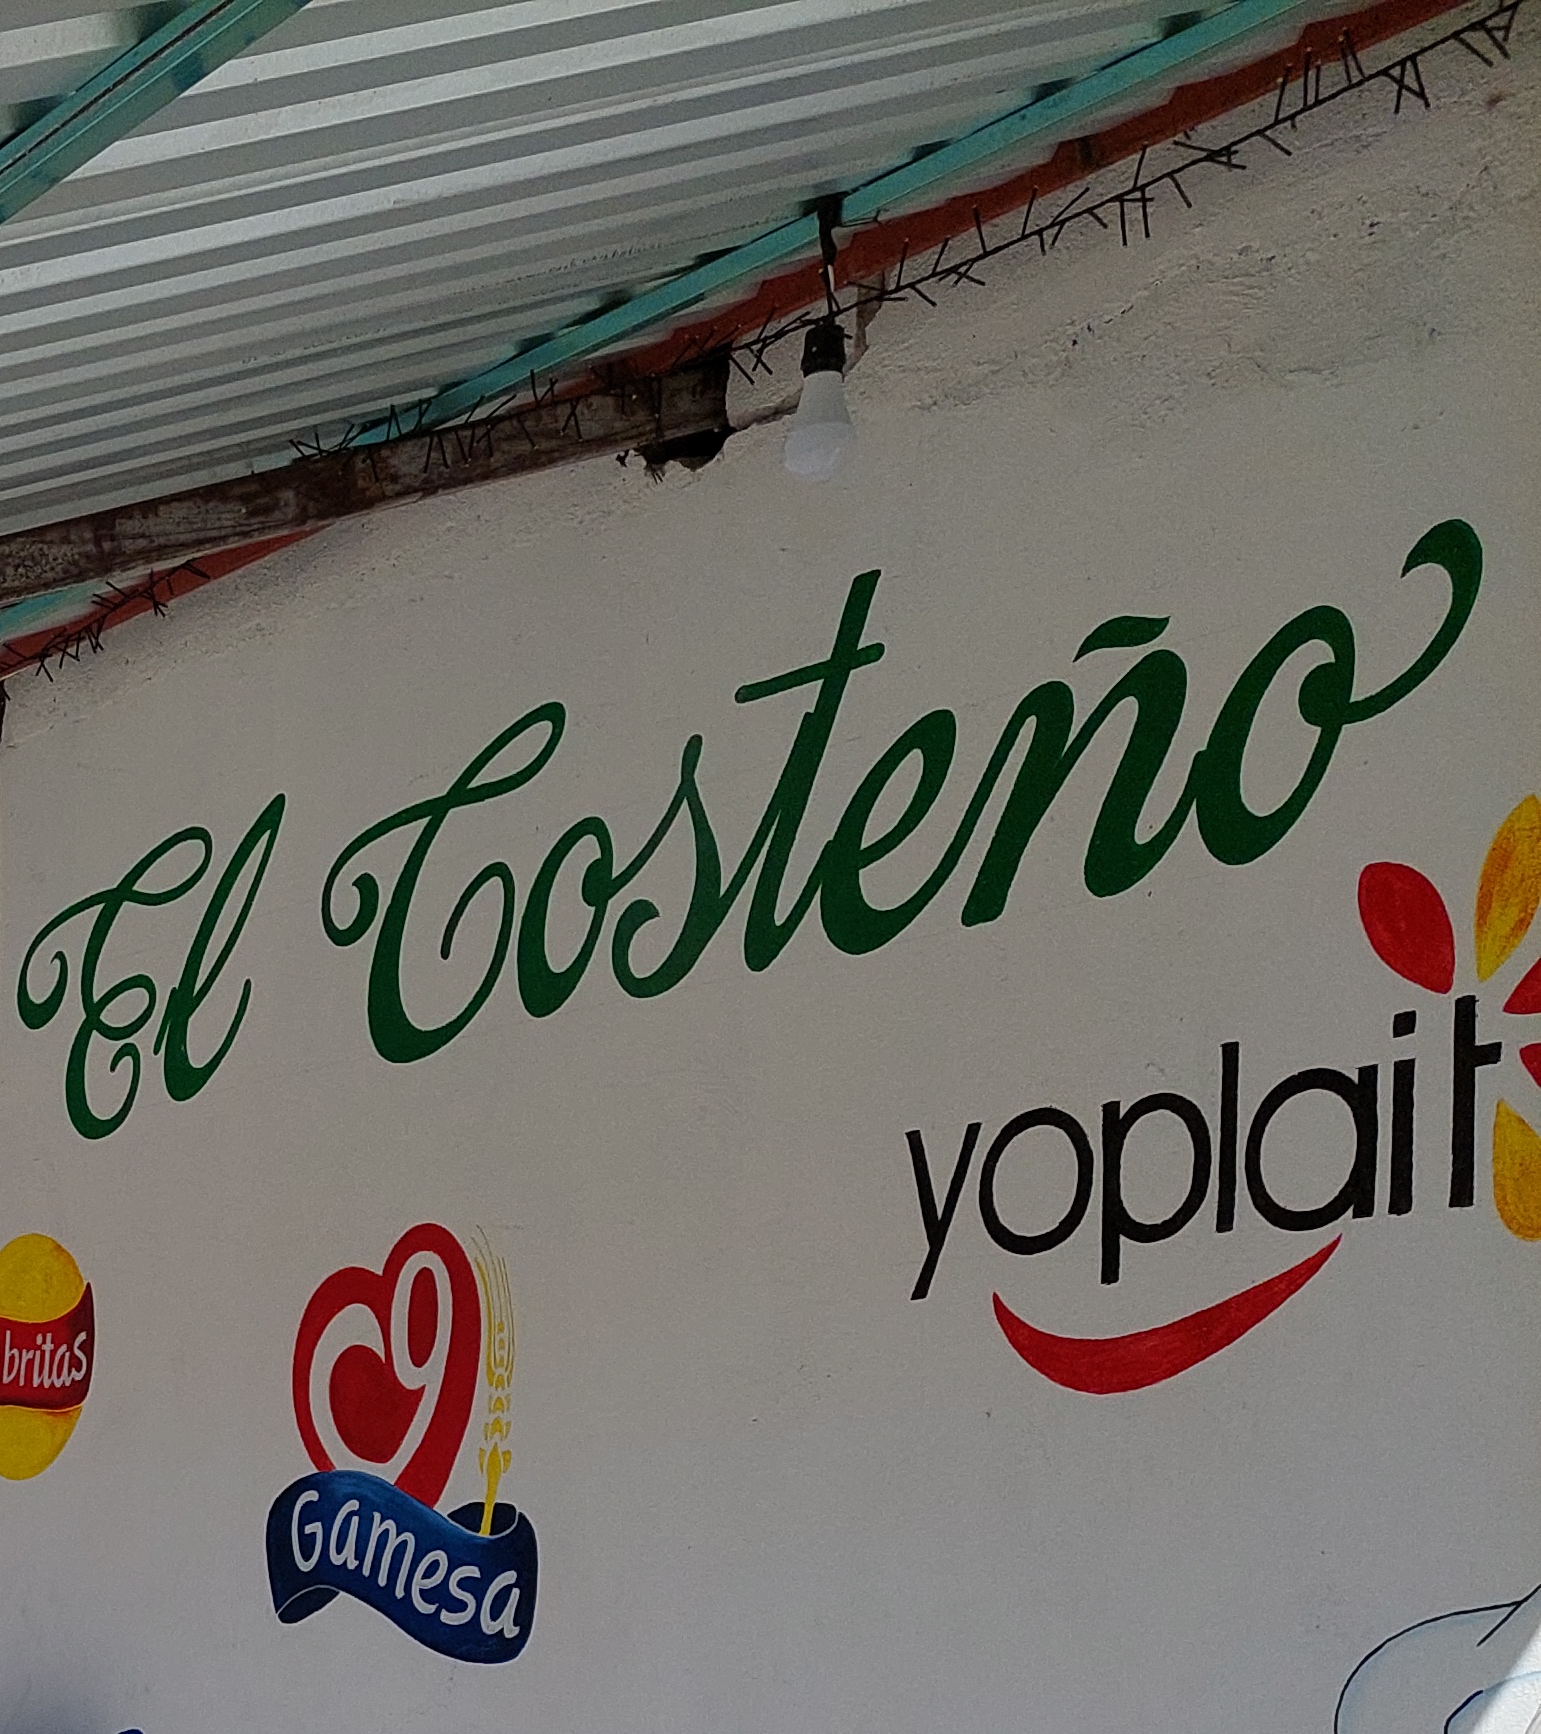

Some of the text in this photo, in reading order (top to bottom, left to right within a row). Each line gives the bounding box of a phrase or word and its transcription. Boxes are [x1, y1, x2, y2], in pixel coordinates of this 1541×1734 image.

[16, 518, 1484, 1140] El Costeño
[904, 994, 1503, 1301] yoplait
[290, 1489, 521, 1639] Gamesa
